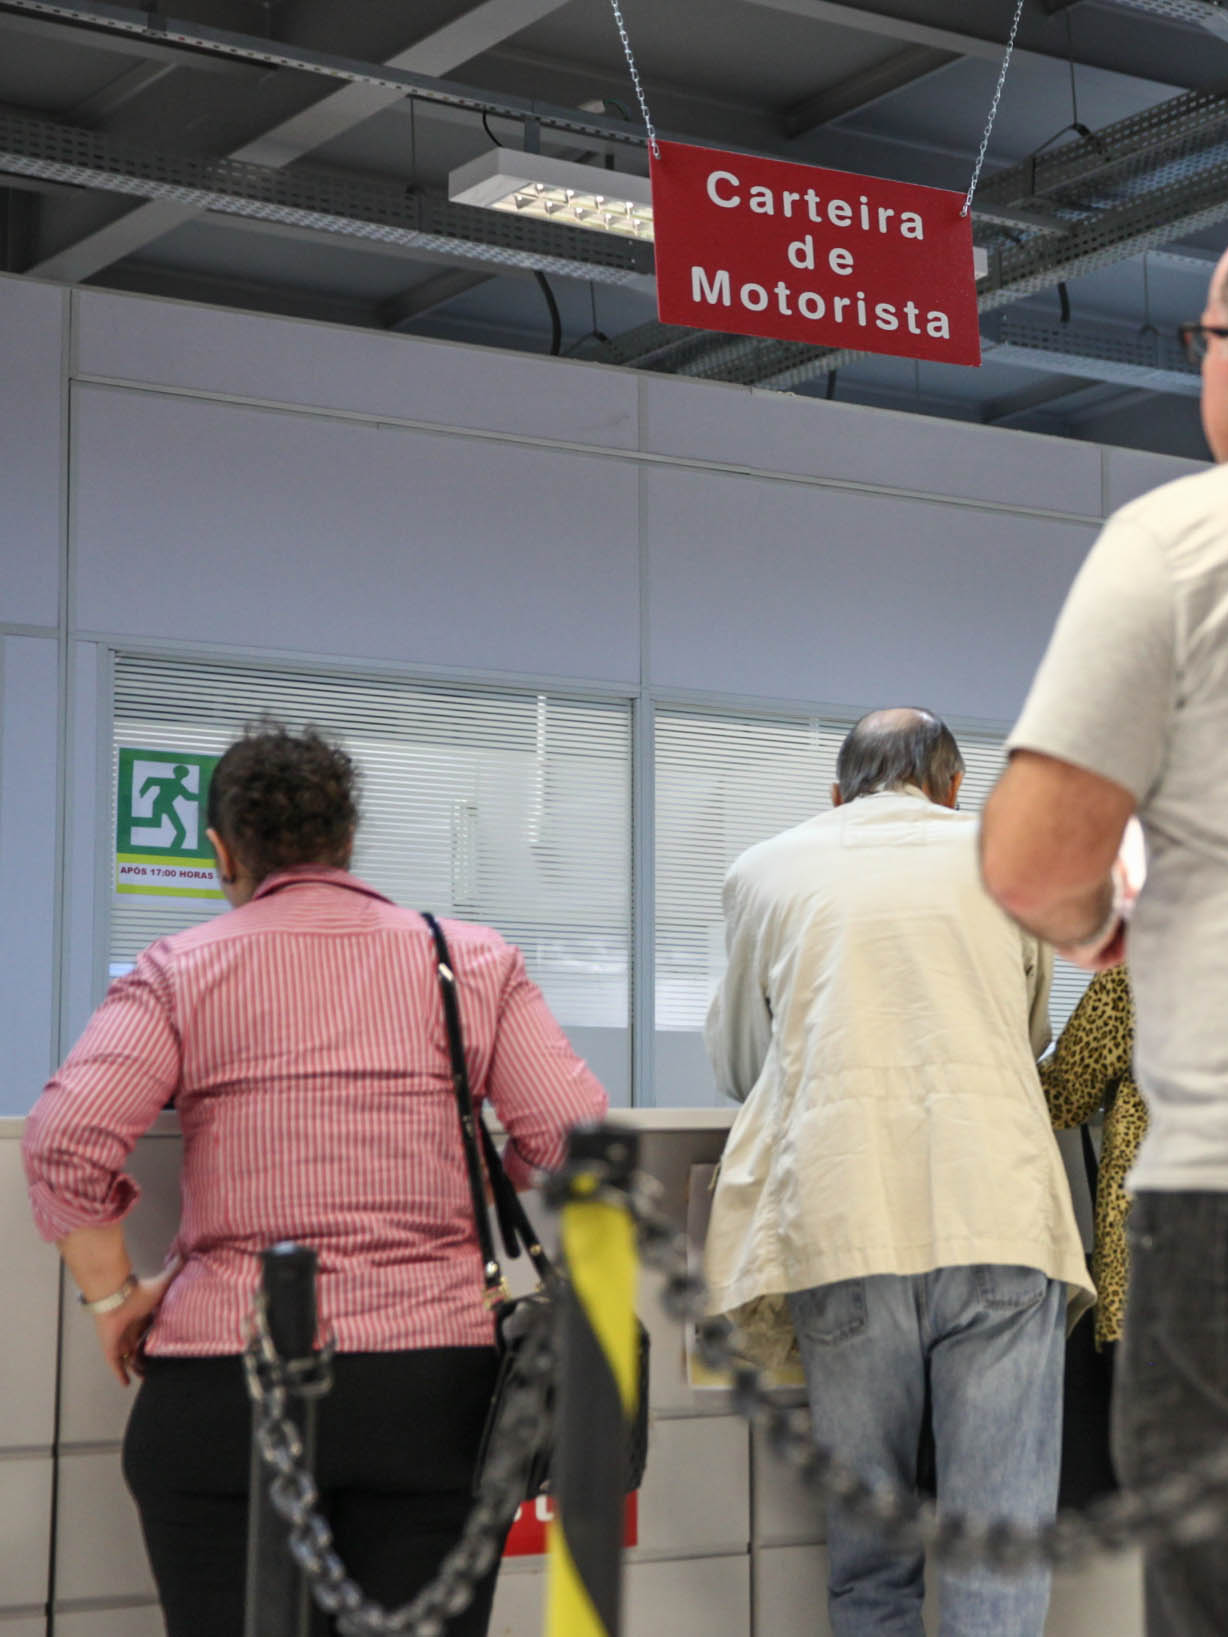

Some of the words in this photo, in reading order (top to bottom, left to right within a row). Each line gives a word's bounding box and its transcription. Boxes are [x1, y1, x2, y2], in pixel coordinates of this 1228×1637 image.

[706, 170, 924, 240] Carteira
[787, 234, 854, 276] de
[691, 265, 950, 339] Motorista
[120, 866, 147, 876] APÓS
[150, 868, 177, 878] 17:00
[179, 870, 214, 880] HORAS
